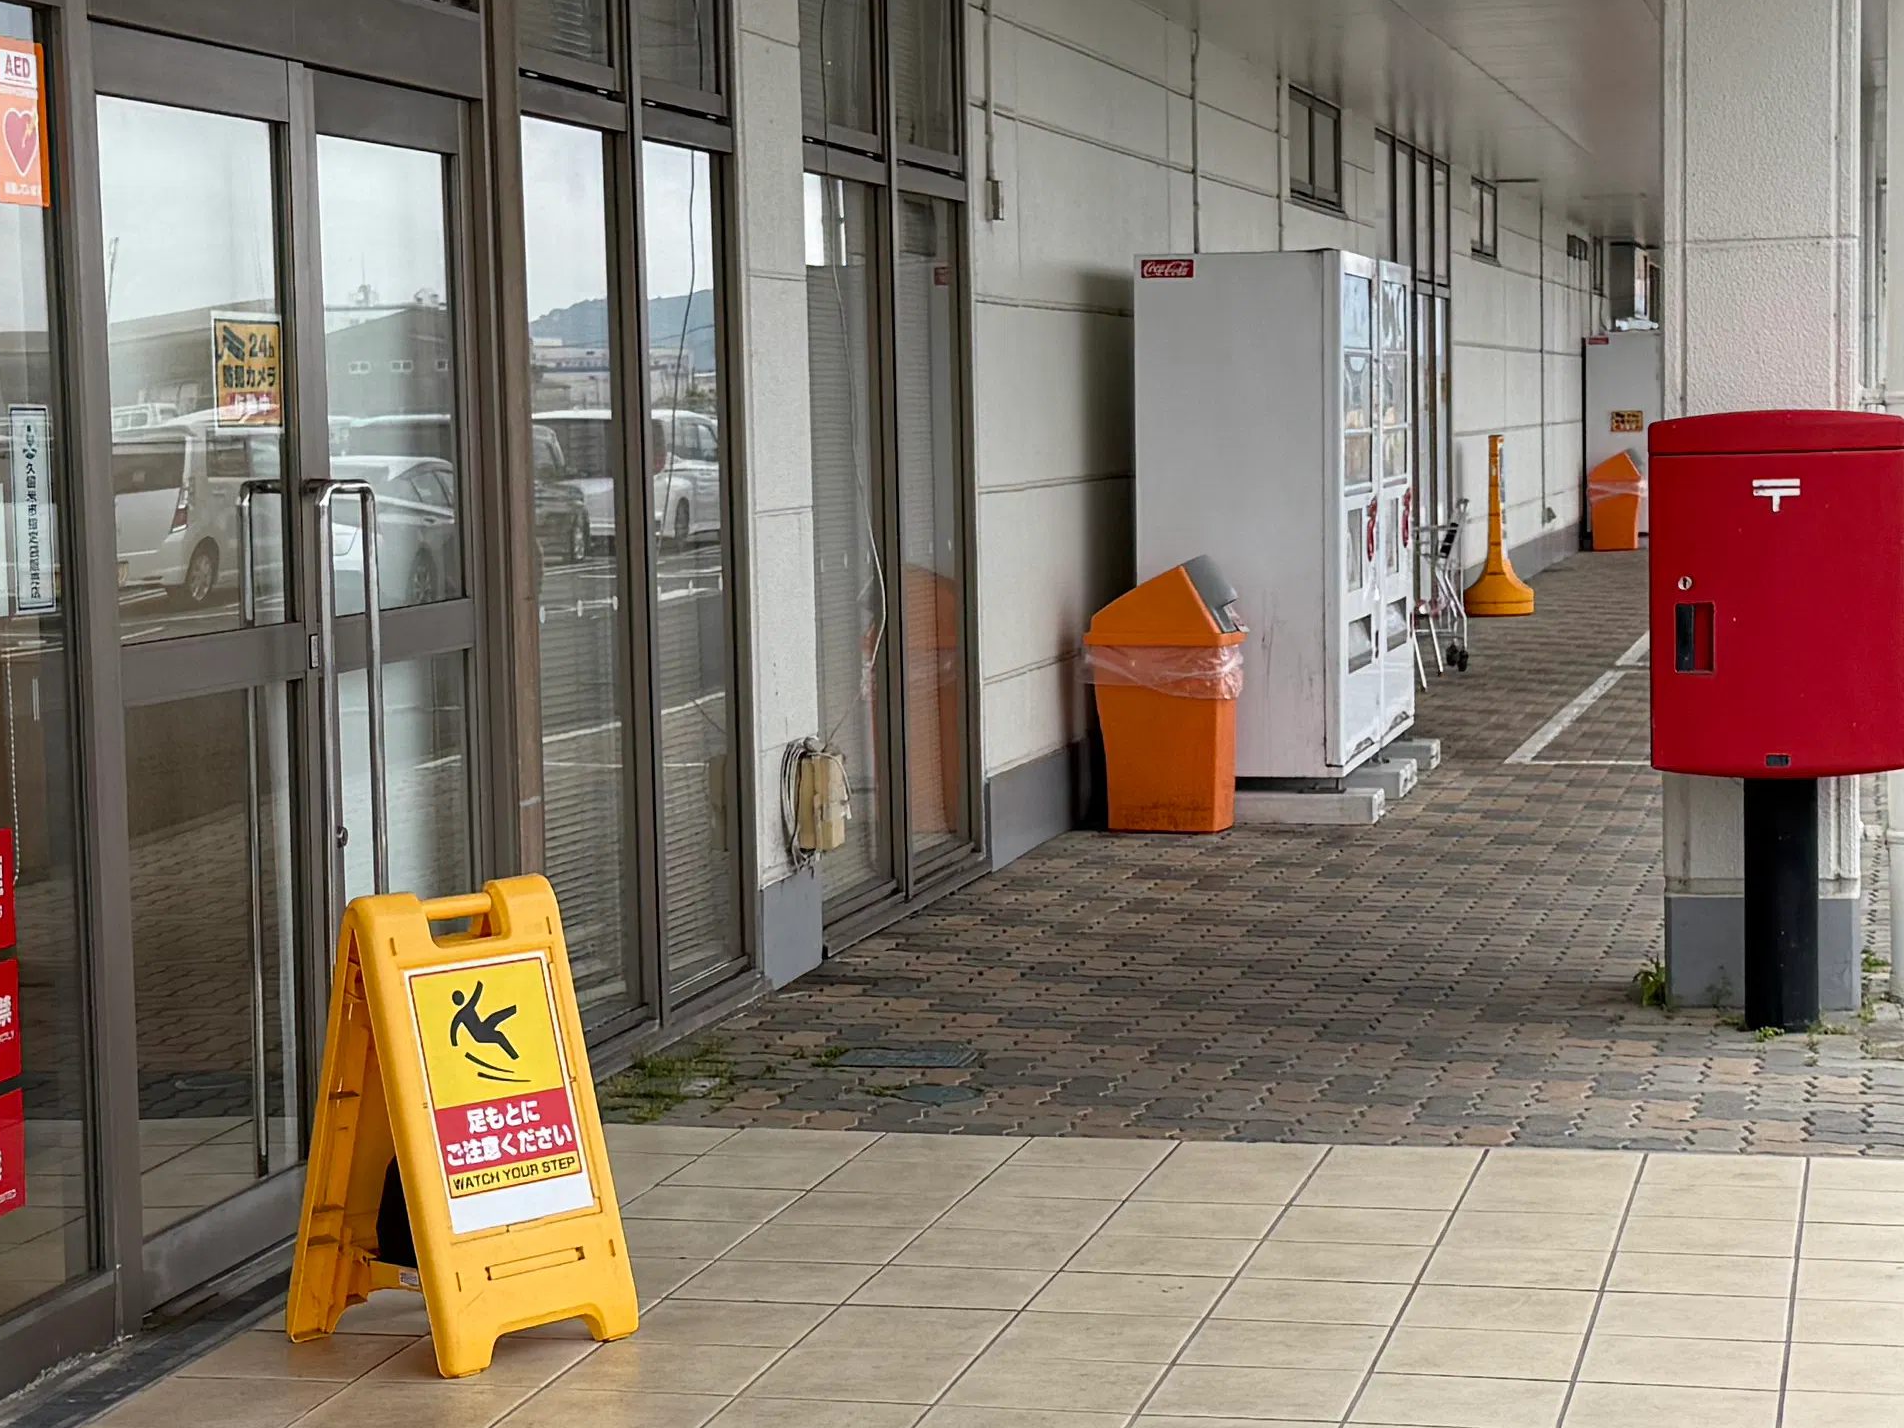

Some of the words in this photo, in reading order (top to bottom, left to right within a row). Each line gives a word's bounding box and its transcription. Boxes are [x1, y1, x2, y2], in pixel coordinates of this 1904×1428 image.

[4, 54, 31, 79] AED
[223, 365, 276, 388] 防犯カメラ
[466, 1100, 541, 1134] 足もとに
[446, 1123, 573, 1167] ご注意ください
[453, 1172, 501, 1191] WATCH
[502, 1163, 539, 1181] YOUR
[542, 1156, 576, 1173] STEP
